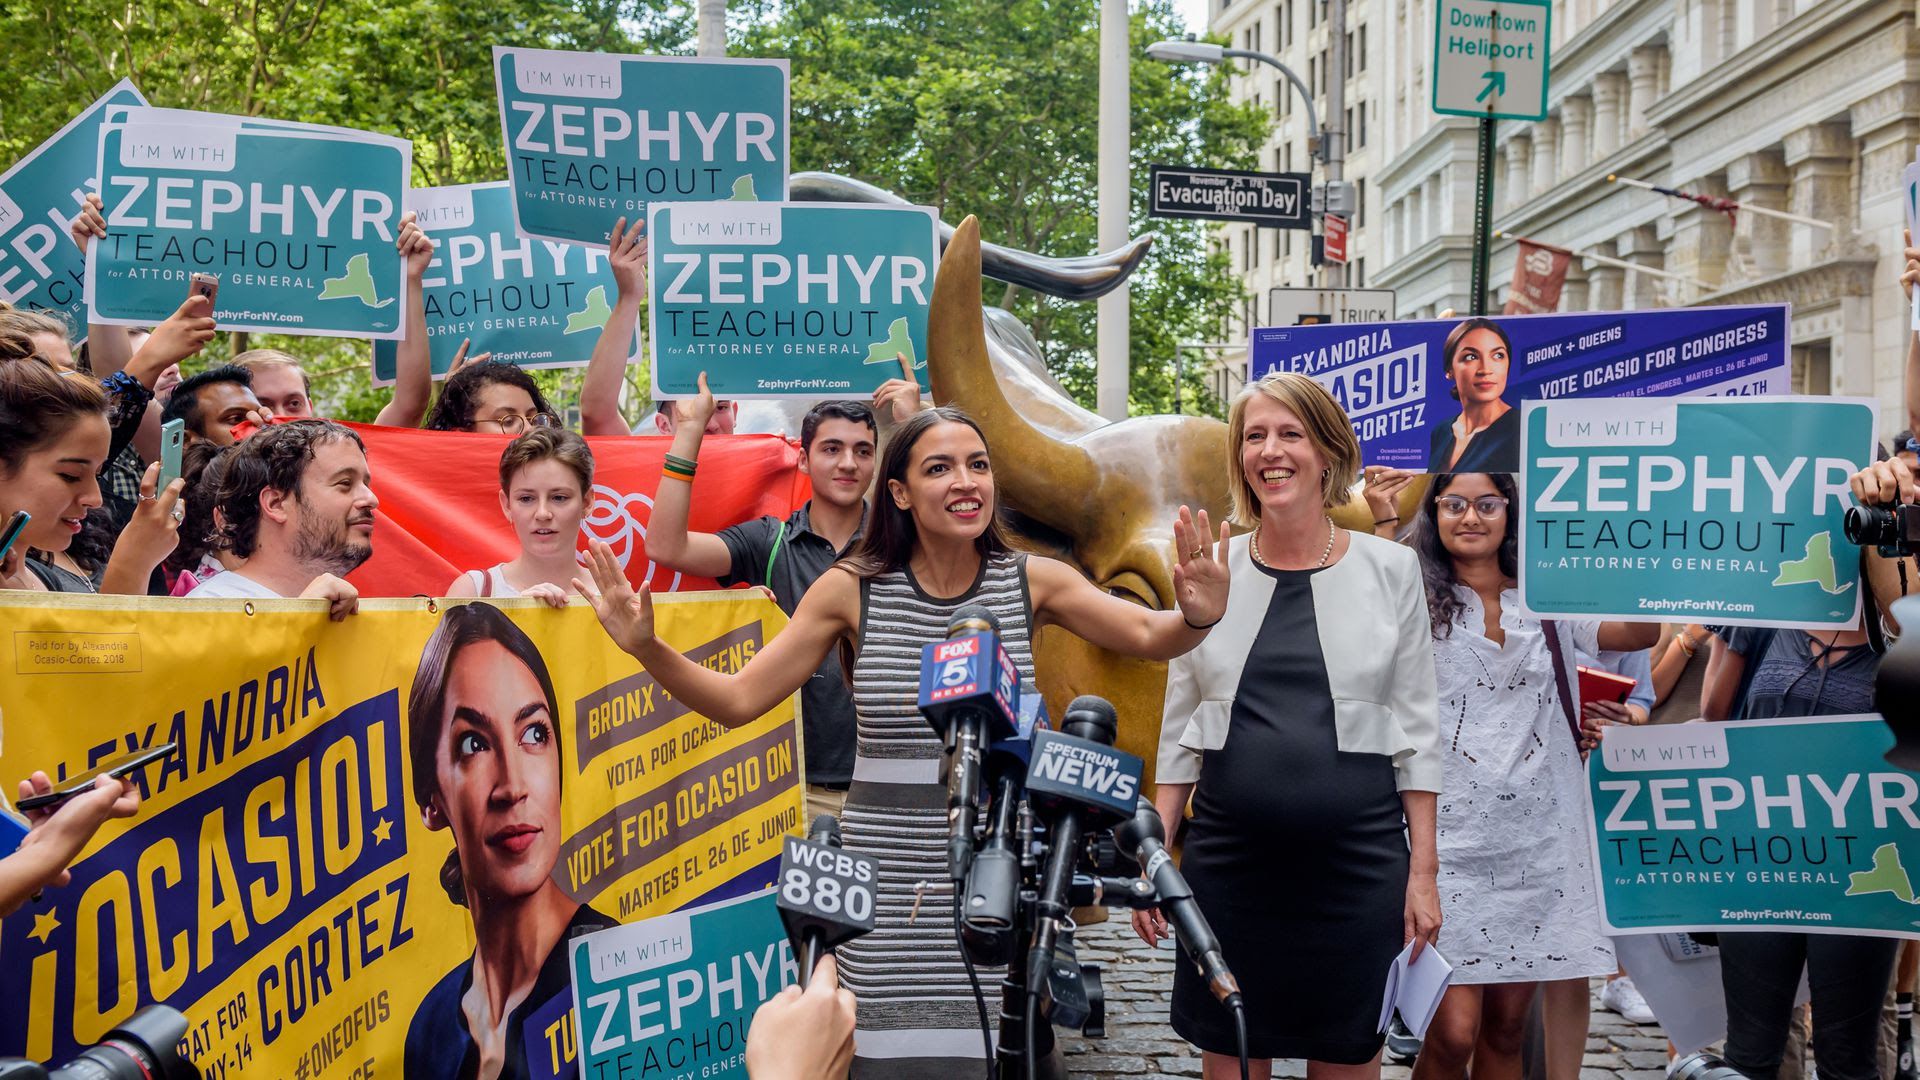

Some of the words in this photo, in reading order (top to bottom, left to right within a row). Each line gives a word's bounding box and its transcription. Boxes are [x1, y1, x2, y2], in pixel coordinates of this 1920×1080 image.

[1451, 8, 1536, 33] Downtown
[1449, 35, 1534, 61] Heliport
[525, 69, 553, 86] I'M
[562, 72, 612, 90] WITH
[511, 100, 777, 162] ZEPHYR
[131, 144, 161, 160] I'M
[172, 146, 226, 163] WITH
[518, 156, 723, 194] TEACHOUT
[1189, 175, 1228, 187] November
[107, 175, 394, 242] ZEPHYR
[525, 190, 537, 199] for
[540, 190, 617, 209] ATTORNEY
[1159, 181, 1258, 207] Evacuation
[1262, 187, 1296, 215] Day
[1215, 204, 1241, 215] PLAZA
[416, 205, 465, 223] WITH
[682, 222, 710, 236] I'M
[722, 222, 771, 236] WITH
[108, 233, 338, 272] TEACHOUT
[107, 269, 123, 278] for
[127, 267, 223, 282] ATTORY
[232, 273, 315, 290] GENERAL
[662, 253, 928, 306] ZEPHYR
[424, 281, 576, 320] ACHOUT
[1340, 308, 1387, 323] TRUCK
[211, 309, 304, 324] ephyrForNY.com
[426, 320, 476, 337] ORNEY
[484, 315, 560, 330] GENERAL
[665, 310, 879, 337] TEACHOUT
[667, 347, 683, 355] for
[686, 343, 775, 355] ATTORNEY
[783, 343, 861, 355] GENERAL
[1526, 342, 1562, 365] BRONX
[1578, 326, 1622, 351] QUEENS
[1539, 374, 1578, 400] VOTE
[1583, 356, 1640, 388] OCASIO
[1645, 347, 1676, 371] FOR
[1682, 320, 1768, 361] CONGRESS
[757, 379, 851, 390] ZephyrForNY.com
[1332, 352, 1420, 413] ASIO!
[1636, 387, 1646, 397] EL
[1686, 369, 1714, 384] MARTES
[1715, 366, 1725, 376] EL
[1726, 363, 1736, 372] 26
[1736, 359, 1746, 369] DE
[1748, 352, 1769, 366] JUNIO
[1558, 421, 1591, 438] I'M
[1604, 420, 1664, 437] WITH
[1534, 454, 1859, 516] ZEPHYR
[1536, 519, 1796, 553] TEACHOUT
[1537, 559, 1553, 569] for
[1558, 556, 1661, 570] ATTORNEY
[1672, 556, 1769, 573] GENERAL
[1638, 597, 1755, 613] ZephyrForNY.com
[29, 640, 48, 651] Paid
[51, 640, 65, 651] for
[68, 640, 80, 653] by
[82, 641, 128, 651] Alexandria
[34, 654, 101, 665] Ocasio-Cortez
[103, 654, 125, 664] 2018
[940, 639, 974, 660] FOX
[941, 657, 969, 687] 5
[588, 682, 655, 741] BRONX
[697, 638, 755, 675] EENS
[934, 684, 974, 698] NEWS
[27, 645, 326, 802] XANDRIA
[606, 754, 646, 791] VOTA
[651, 737, 677, 771] POR
[1043, 741, 1120, 769] SPECTRUM
[1614, 747, 1648, 763] I'M
[1659, 745, 1717, 761] WITH
[1033, 754, 1137, 801] NEWS
[567, 831, 615, 892] VOTE
[621, 800, 669, 857] FOR
[675, 755, 760, 829] OCASIO
[766, 739, 793, 783] ON
[1599, 772, 1920, 832] ZEPHYR
[619, 865, 679, 919] MARTES
[684, 855, 703, 879] EL
[708, 841, 728, 870] 26
[732, 829, 751, 854] DE
[757, 805, 797, 845] JUNIO
[790, 841, 872, 882] WCBS
[1608, 835, 1858, 866] TEACHOUT
[1615, 876, 1632, 886] for
[1636, 871, 1737, 885] ATTORNEY
[1746, 871, 1840, 884] GENERAL
[782, 868, 872, 922] 880
[1720, 909, 1832, 922] ZephyrForNY.com
[256, 873, 414, 1046] CORTEZ
[600, 950, 626, 971] I'M
[637, 935, 683, 960] WITH
[586, 937, 799, 1056] ZEPHYR
[217, 991, 248, 1040] FOR
[295, 990, 391, 1080] #ONEOFUS
[593, 1012, 754, 1080] TEACHOU
[702, 1052, 745, 1079] GENER
